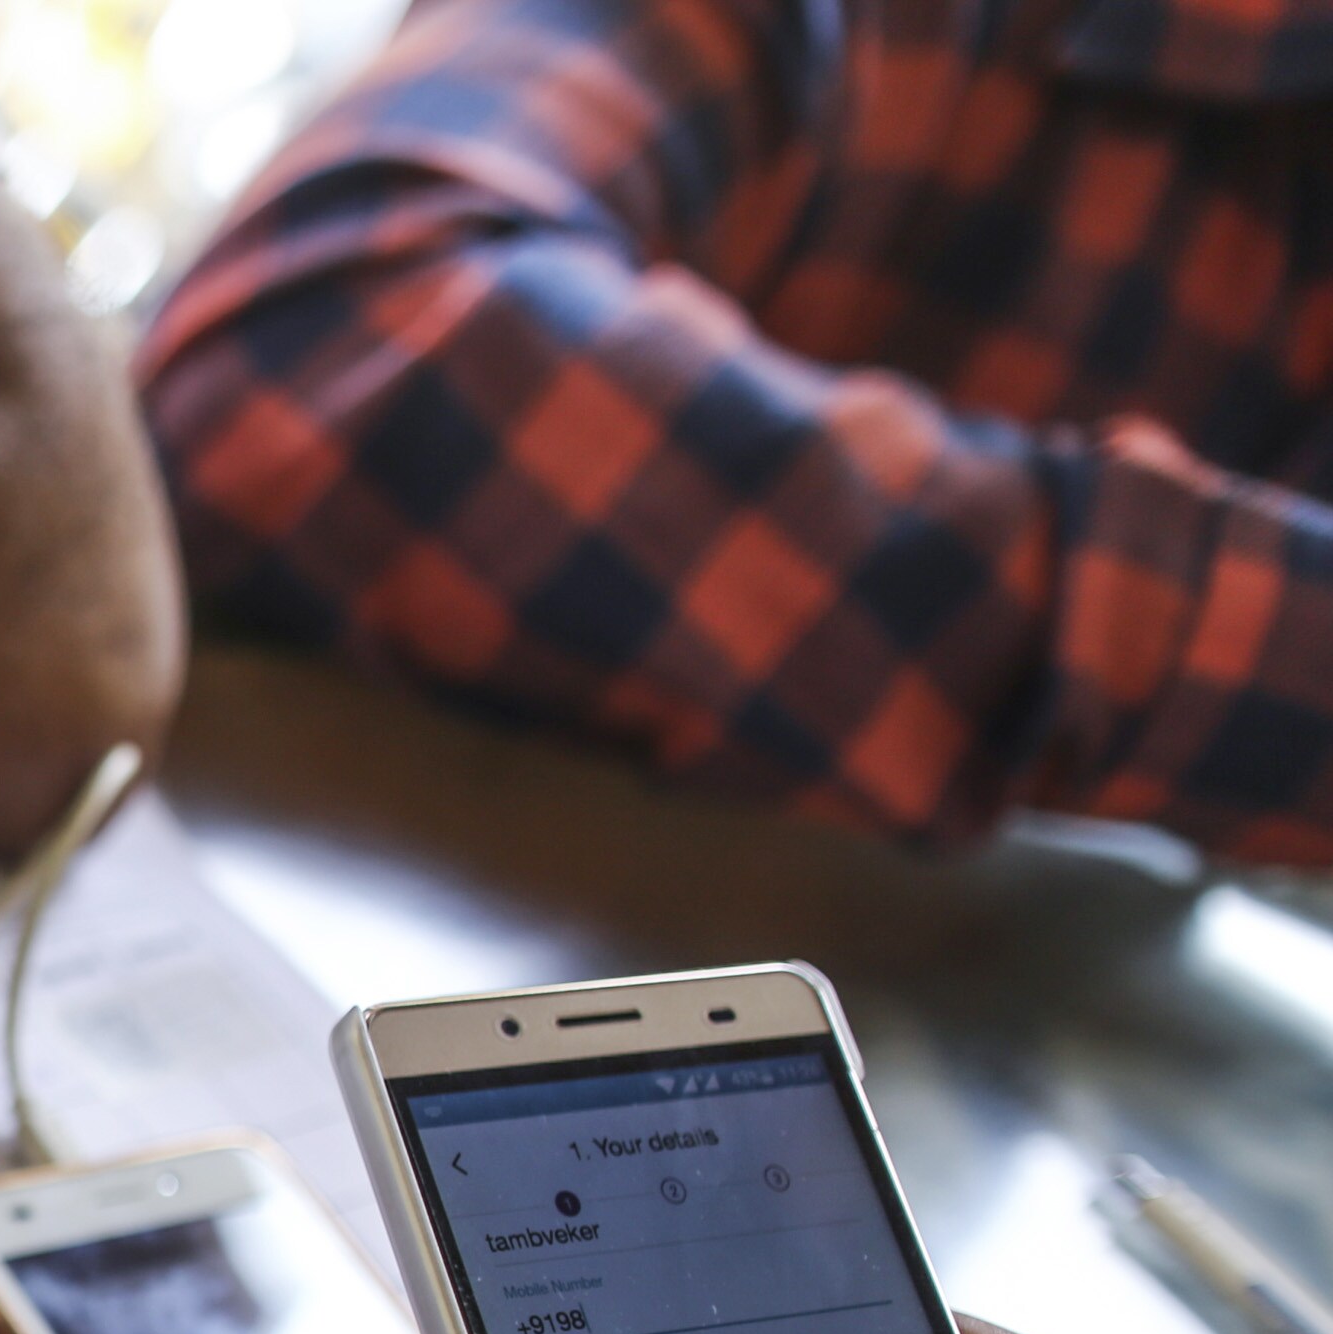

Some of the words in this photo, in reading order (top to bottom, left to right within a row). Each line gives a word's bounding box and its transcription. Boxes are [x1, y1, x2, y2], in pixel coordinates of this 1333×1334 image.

[569, 1141, 591, 1160] 1.
[593, 1137, 642, 1158] Your
[648, 1128, 719, 1151] details
[485, 1223, 599, 1252] tambveker
[503, 1282, 549, 1299] Mobile
[550, 1277, 603, 1294] Number
